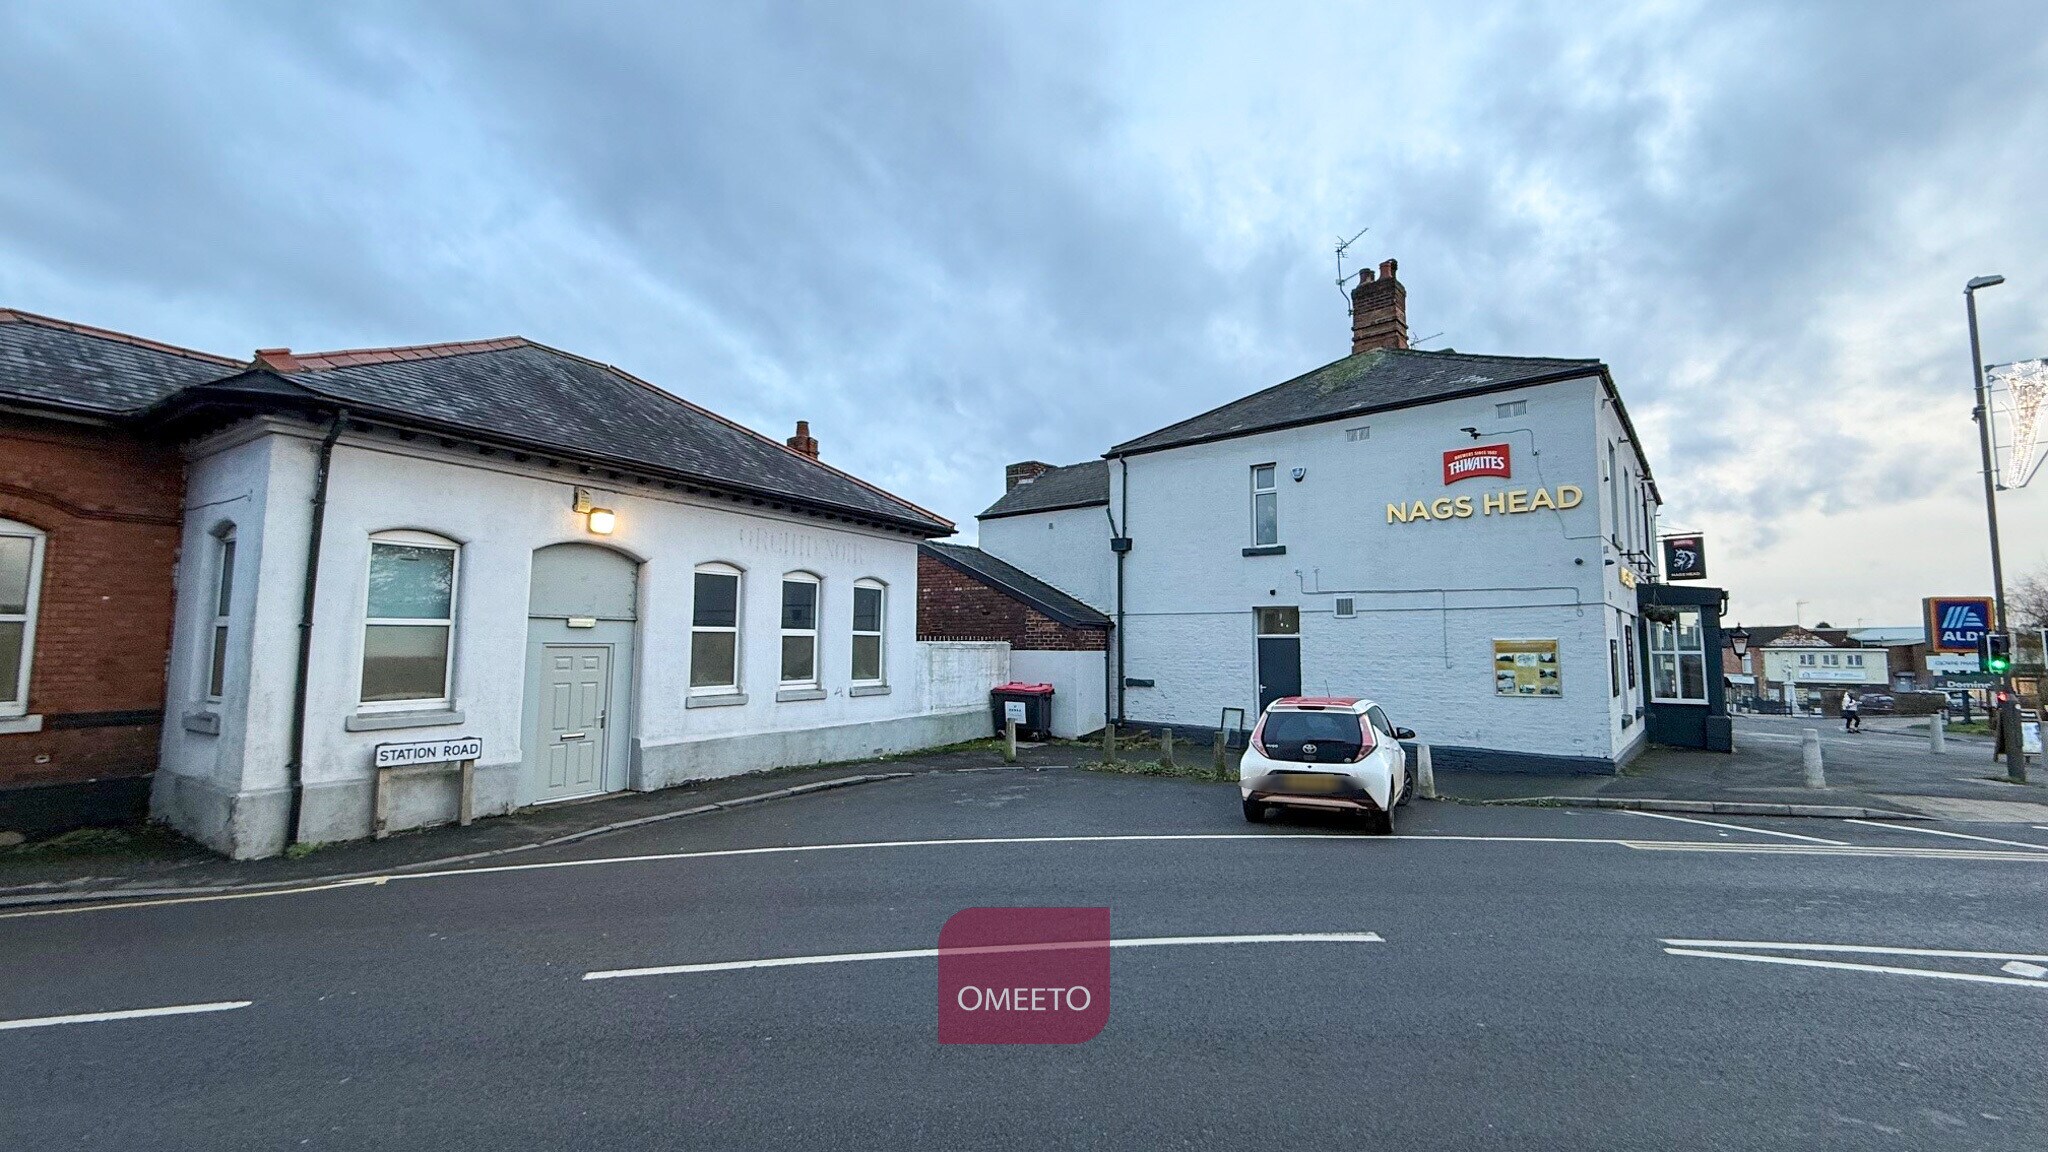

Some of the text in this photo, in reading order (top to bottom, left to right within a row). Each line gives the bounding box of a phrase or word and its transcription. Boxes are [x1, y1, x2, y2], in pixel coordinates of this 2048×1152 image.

[1448, 456, 1505, 475] THWAITES
[1387, 485, 1583, 524] NAGS HEAD
[379, 743, 479, 762] STATION ROAD
